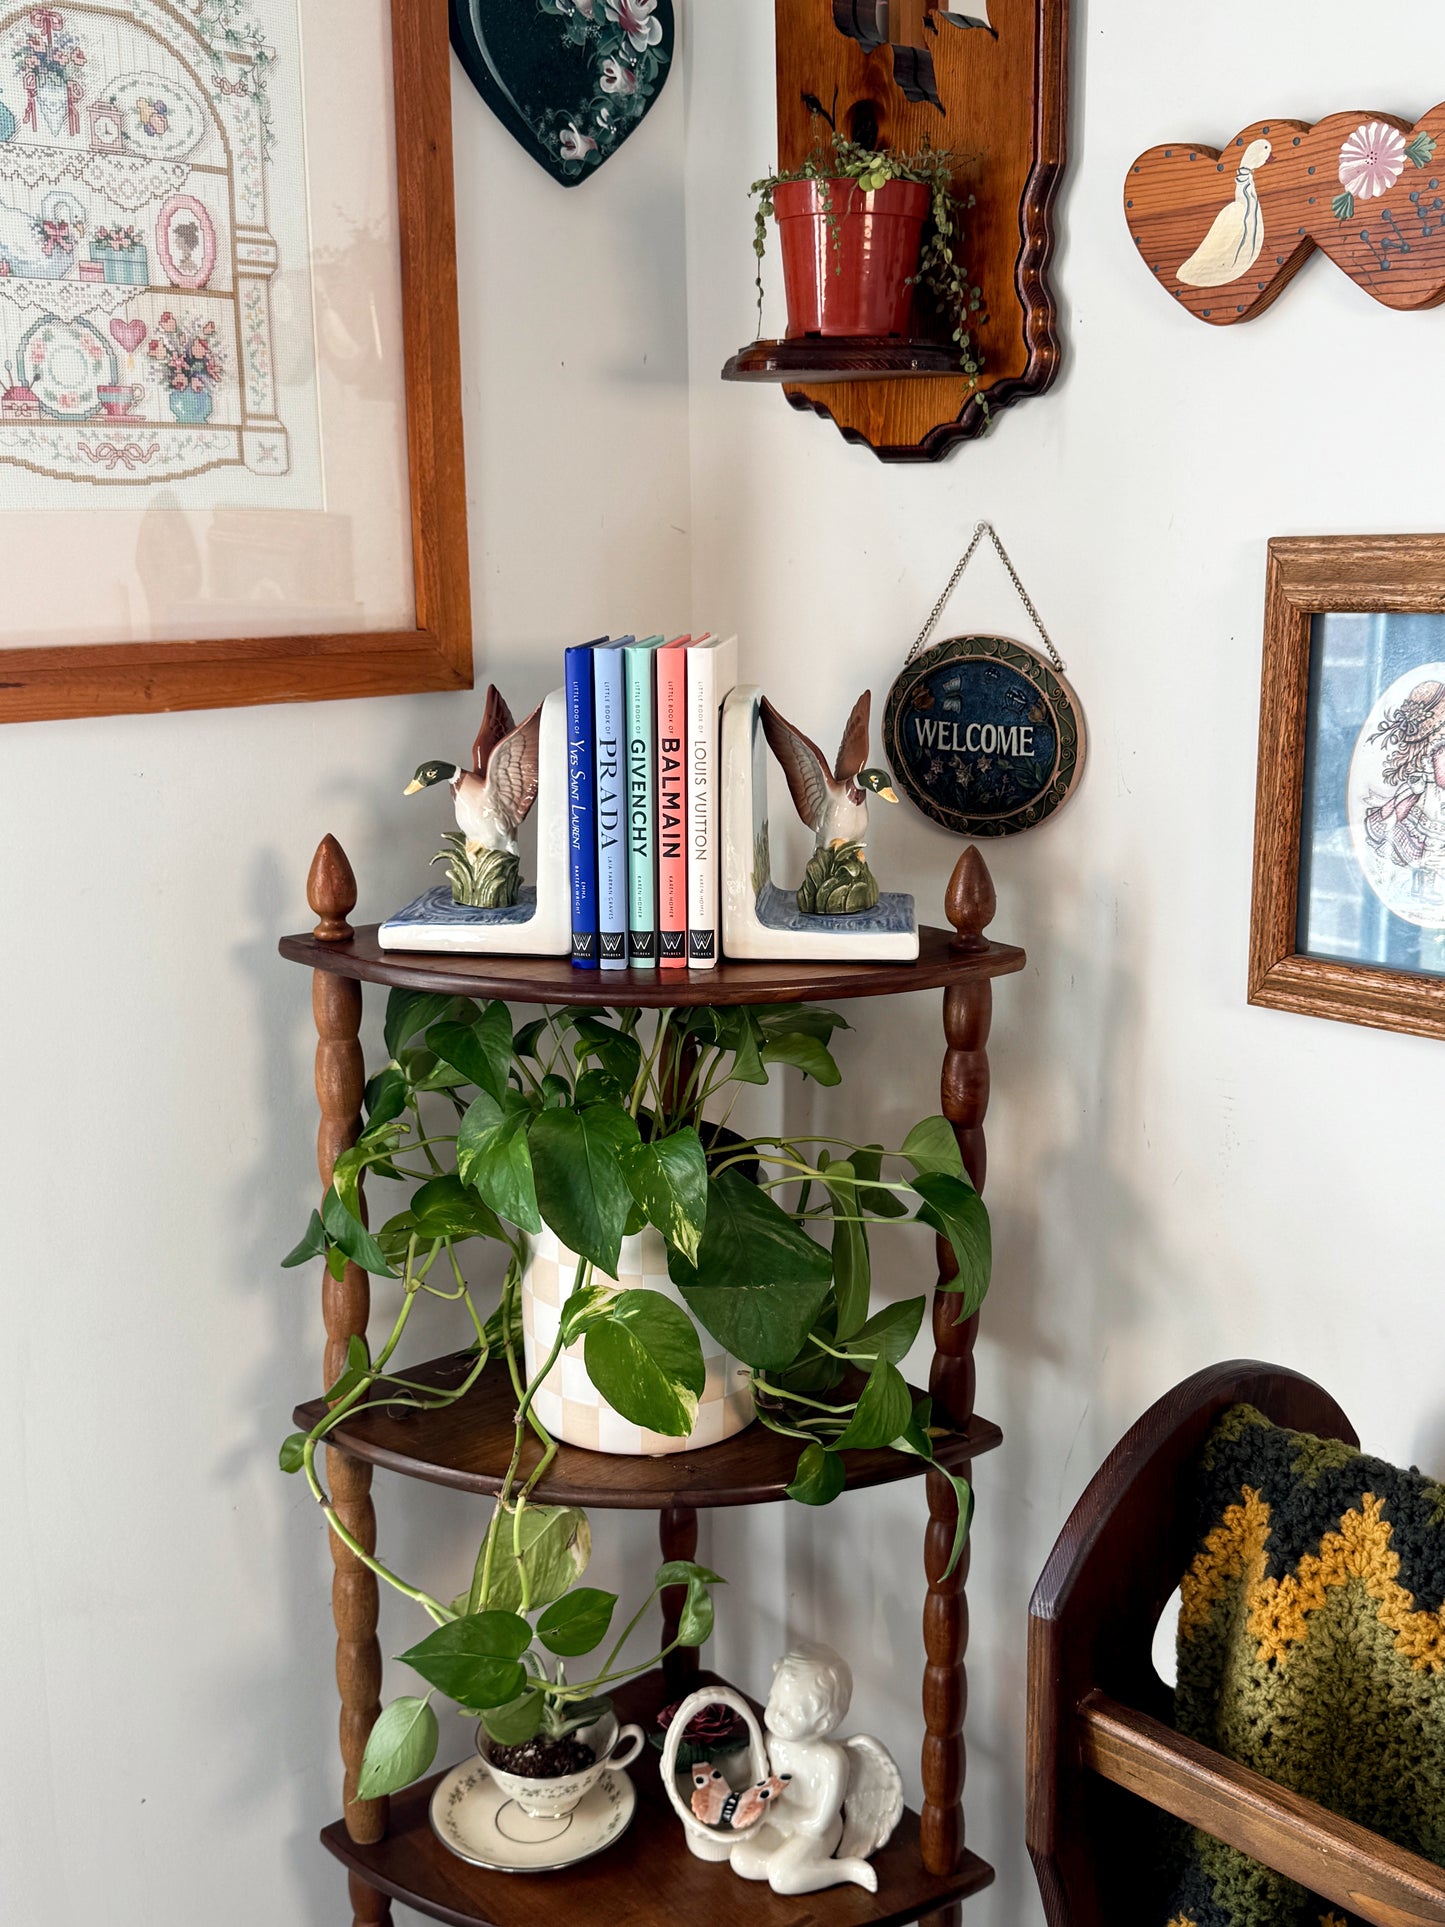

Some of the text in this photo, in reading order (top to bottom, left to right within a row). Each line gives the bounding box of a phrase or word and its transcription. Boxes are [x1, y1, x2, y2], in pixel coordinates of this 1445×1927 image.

[574, 725, 580, 734] OF
[605, 726, 611, 734] OF
[635, 725, 641, 734] OF
[668, 725, 674, 734] OF
[698, 725, 704, 733] OF
[914, 718, 1035, 756] WELCOME
[570, 740, 586, 850] YVES SAINT LAURENT
[600, 738, 618, 850] PRADA
[631, 739, 647, 858] GIVENCHY
[662, 738, 680, 858] BALMAIN
[694, 741, 707, 860] LOUIS VUITTON
